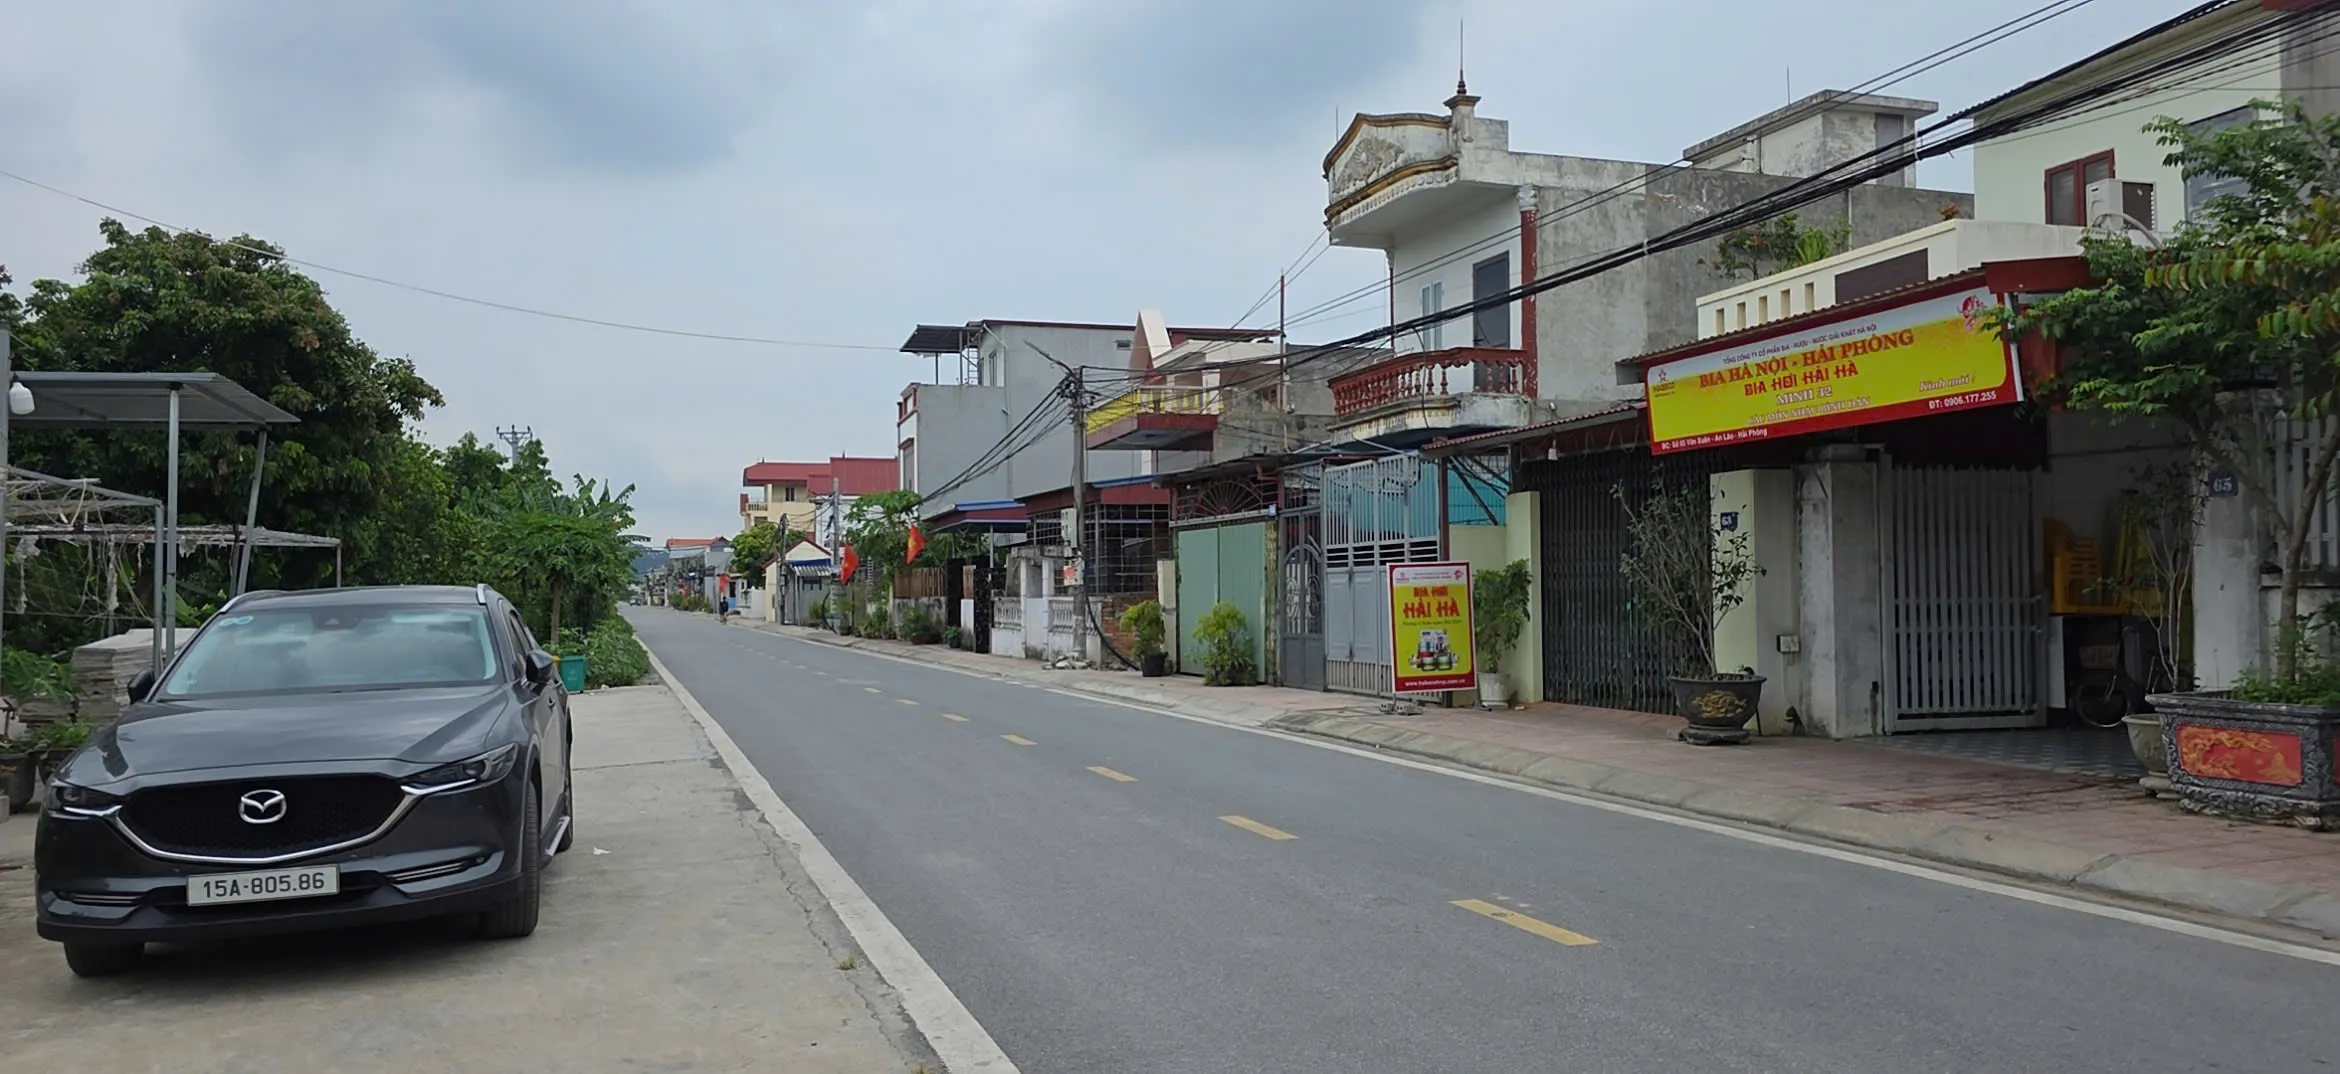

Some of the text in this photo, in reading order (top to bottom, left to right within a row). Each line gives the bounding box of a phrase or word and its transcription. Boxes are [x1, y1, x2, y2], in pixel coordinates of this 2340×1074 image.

[1699, 371, 1725, 388] BIA
[1728, 362, 1753, 384] HÀ
[1755, 356, 1788, 378] NỘI
[1802, 343, 1836, 368] HẢI
[1840, 328, 1915, 359] PHÒNG
[1744, 359, 1859, 396] BIA HƠI HẢI HÀ
[1777, 385, 1833, 406] MINH 32
[2213, 476, 2233, 492] 65
[1403, 596, 1460, 618] HẢI HÀ
[203, 872, 325, 898] 15A-805.86
